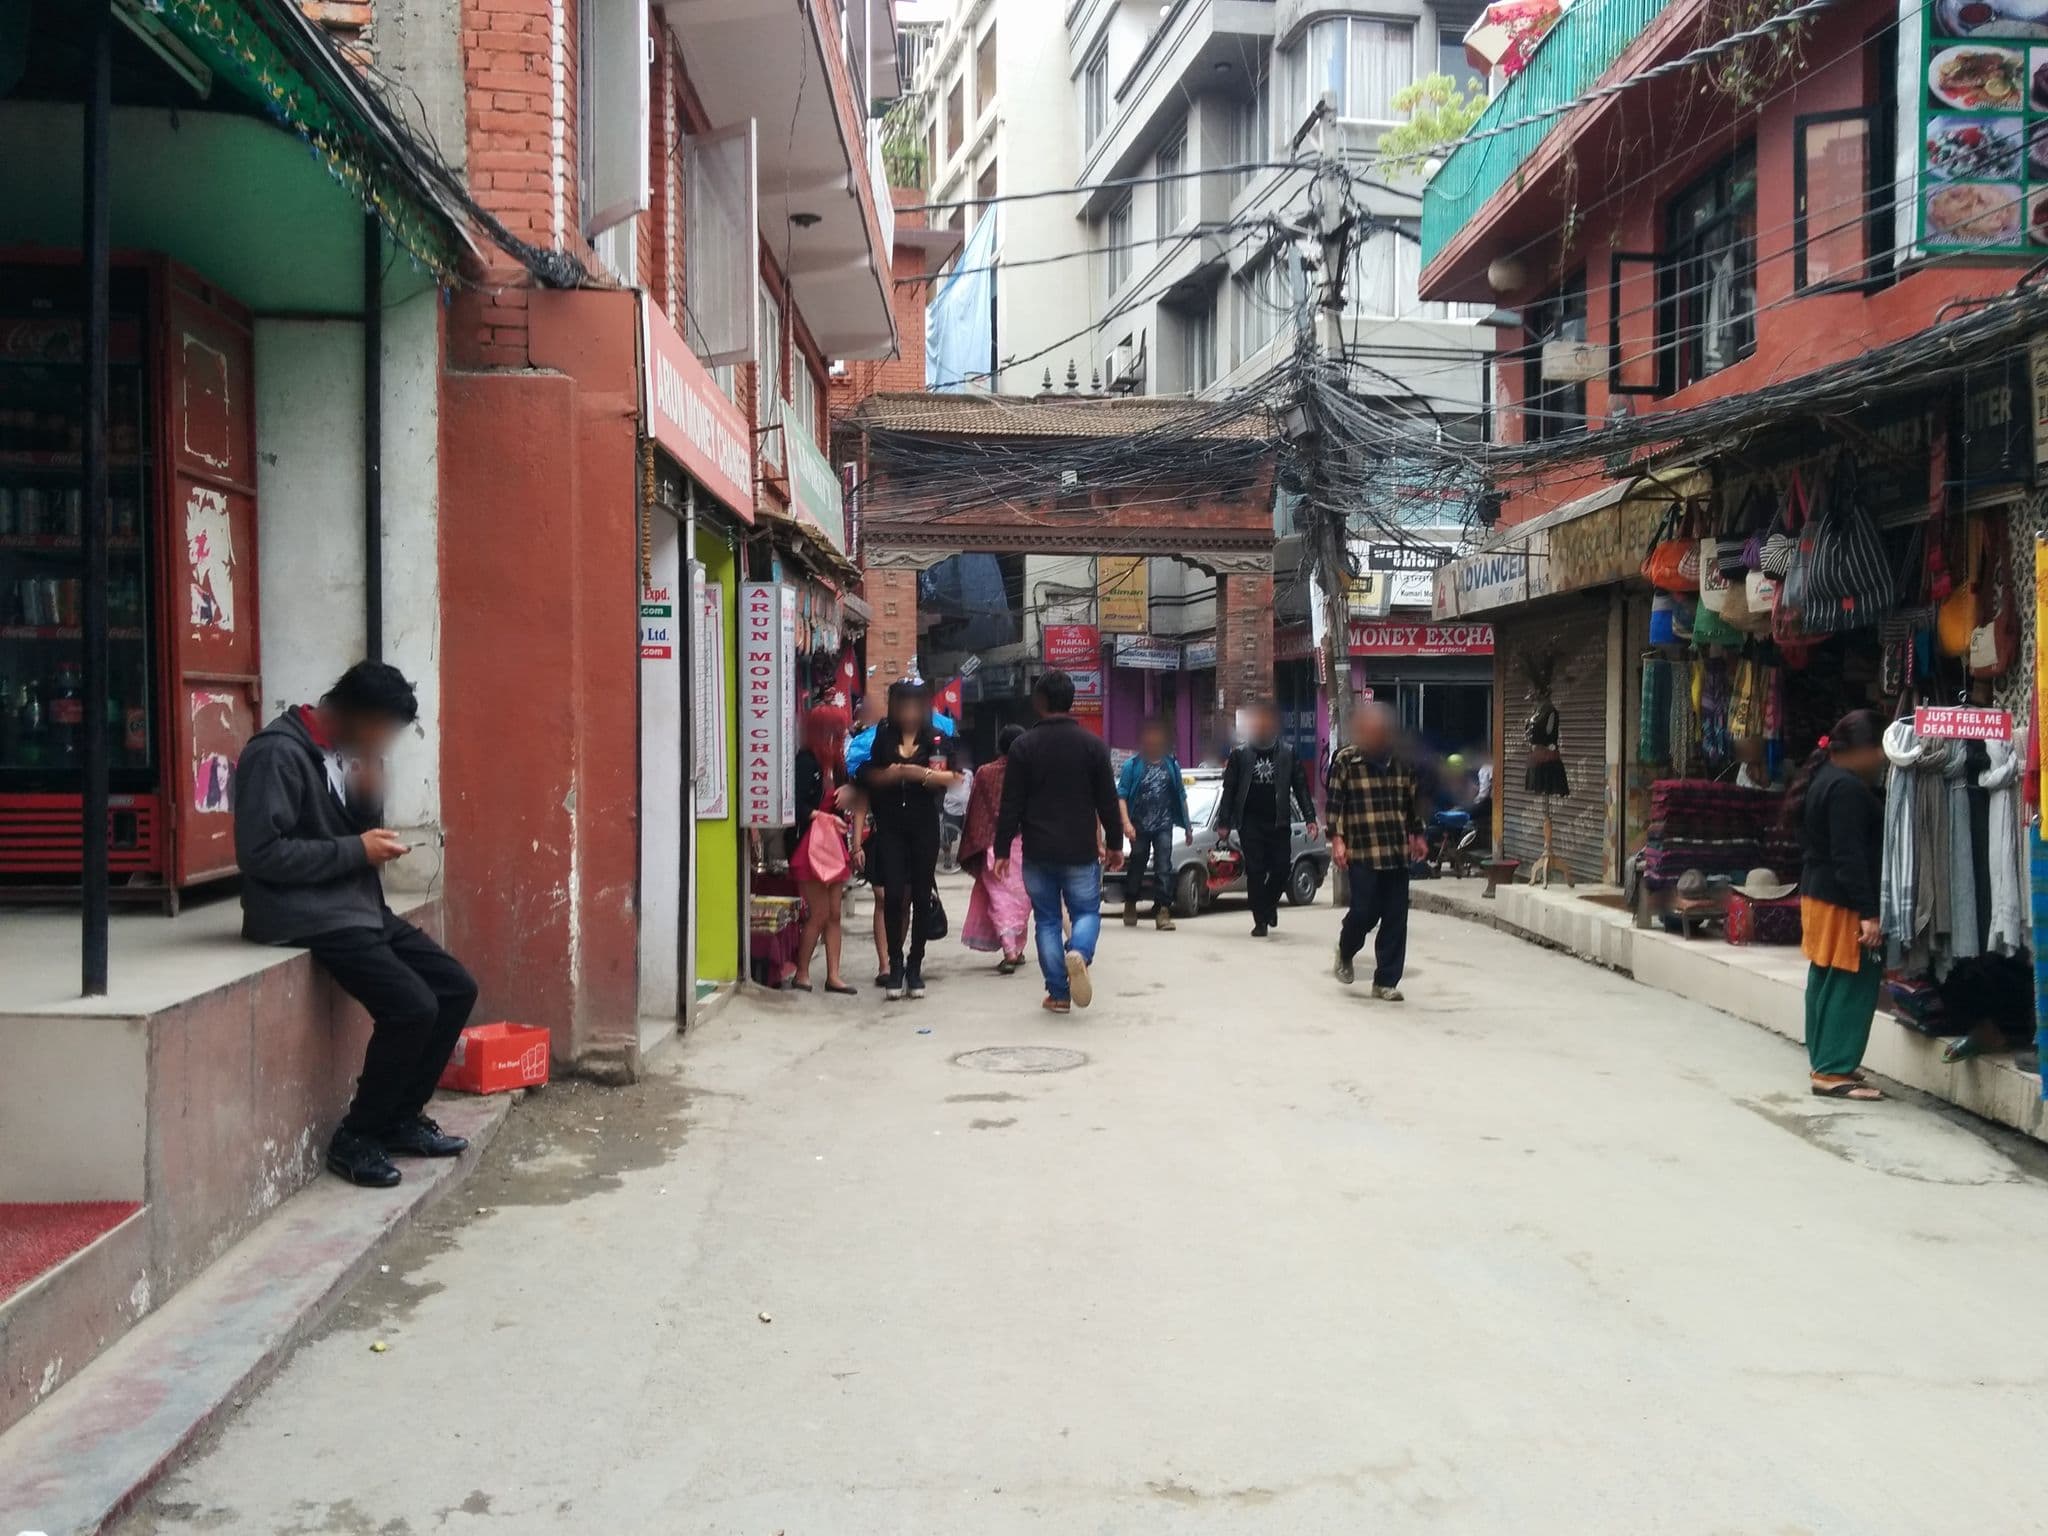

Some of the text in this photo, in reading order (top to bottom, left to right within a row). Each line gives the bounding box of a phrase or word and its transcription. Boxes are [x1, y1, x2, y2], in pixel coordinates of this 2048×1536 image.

[657, 349, 686, 434] ARUN
[685, 383, 716, 464] MONEY
[716, 421, 752, 500] CHANGER
[1393, 558, 1434, 568] UNION
[644, 586, 670, 602] Expd.
[648, 627, 670, 641] Ltd.
[1349, 627, 1419, 646] MONEY
[748, 588, 772, 824] ARUN MONEY CHANGER
[1926, 711, 2002, 725] JUST FEEL ME
[1922, 723, 2004, 738] DEAR HUMAN
